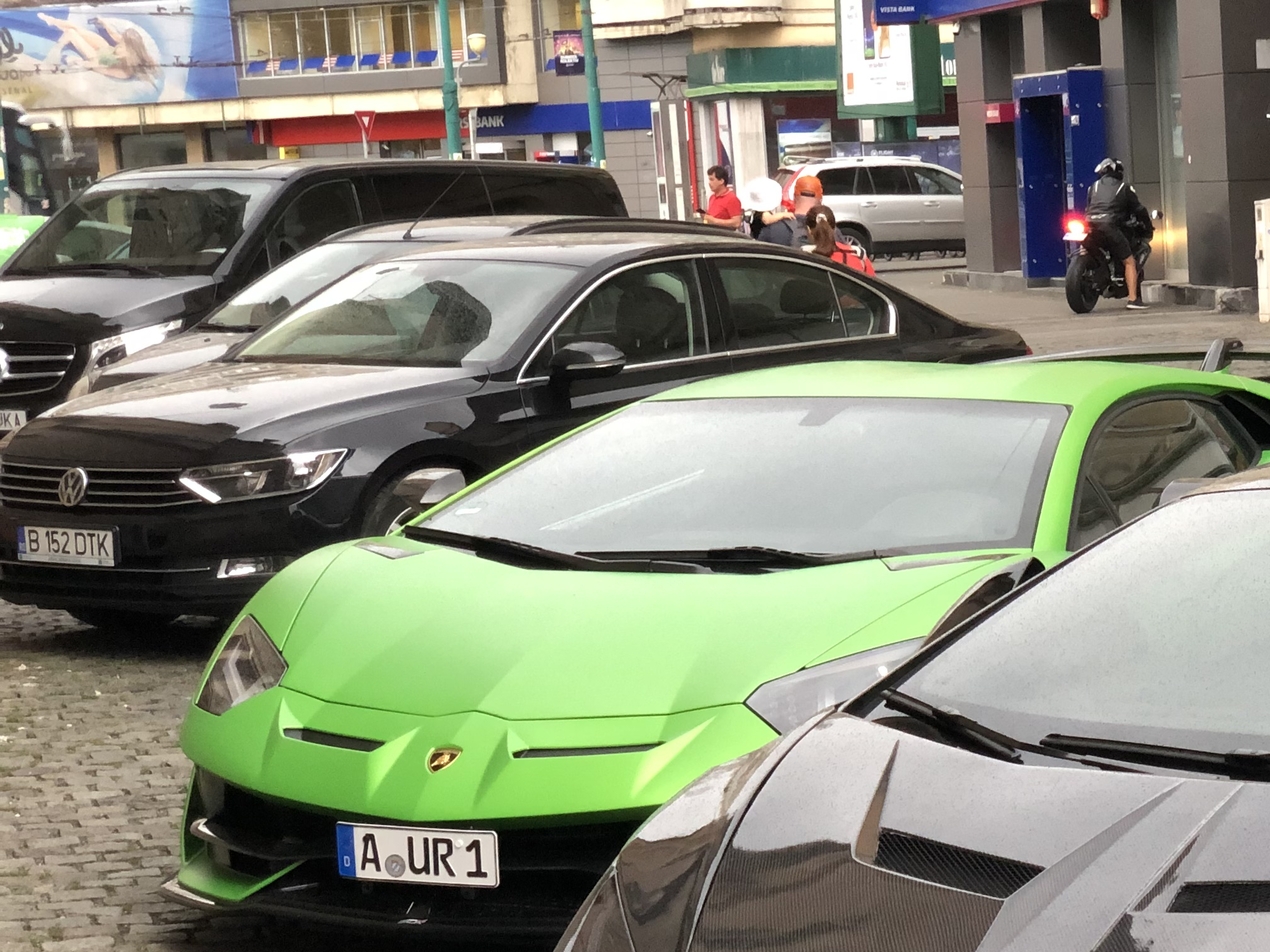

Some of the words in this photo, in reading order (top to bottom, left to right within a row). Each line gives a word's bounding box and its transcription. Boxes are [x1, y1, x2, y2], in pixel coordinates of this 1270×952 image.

[28, 529, 40, 553] B
[45, 530, 71, 554] 152
[74, 532, 109, 557] DTK
[343, 855, 351, 868] D
[360, 833, 382, 872] A
[407, 836, 456, 877] UR
[465, 839, 488, 878] 1
